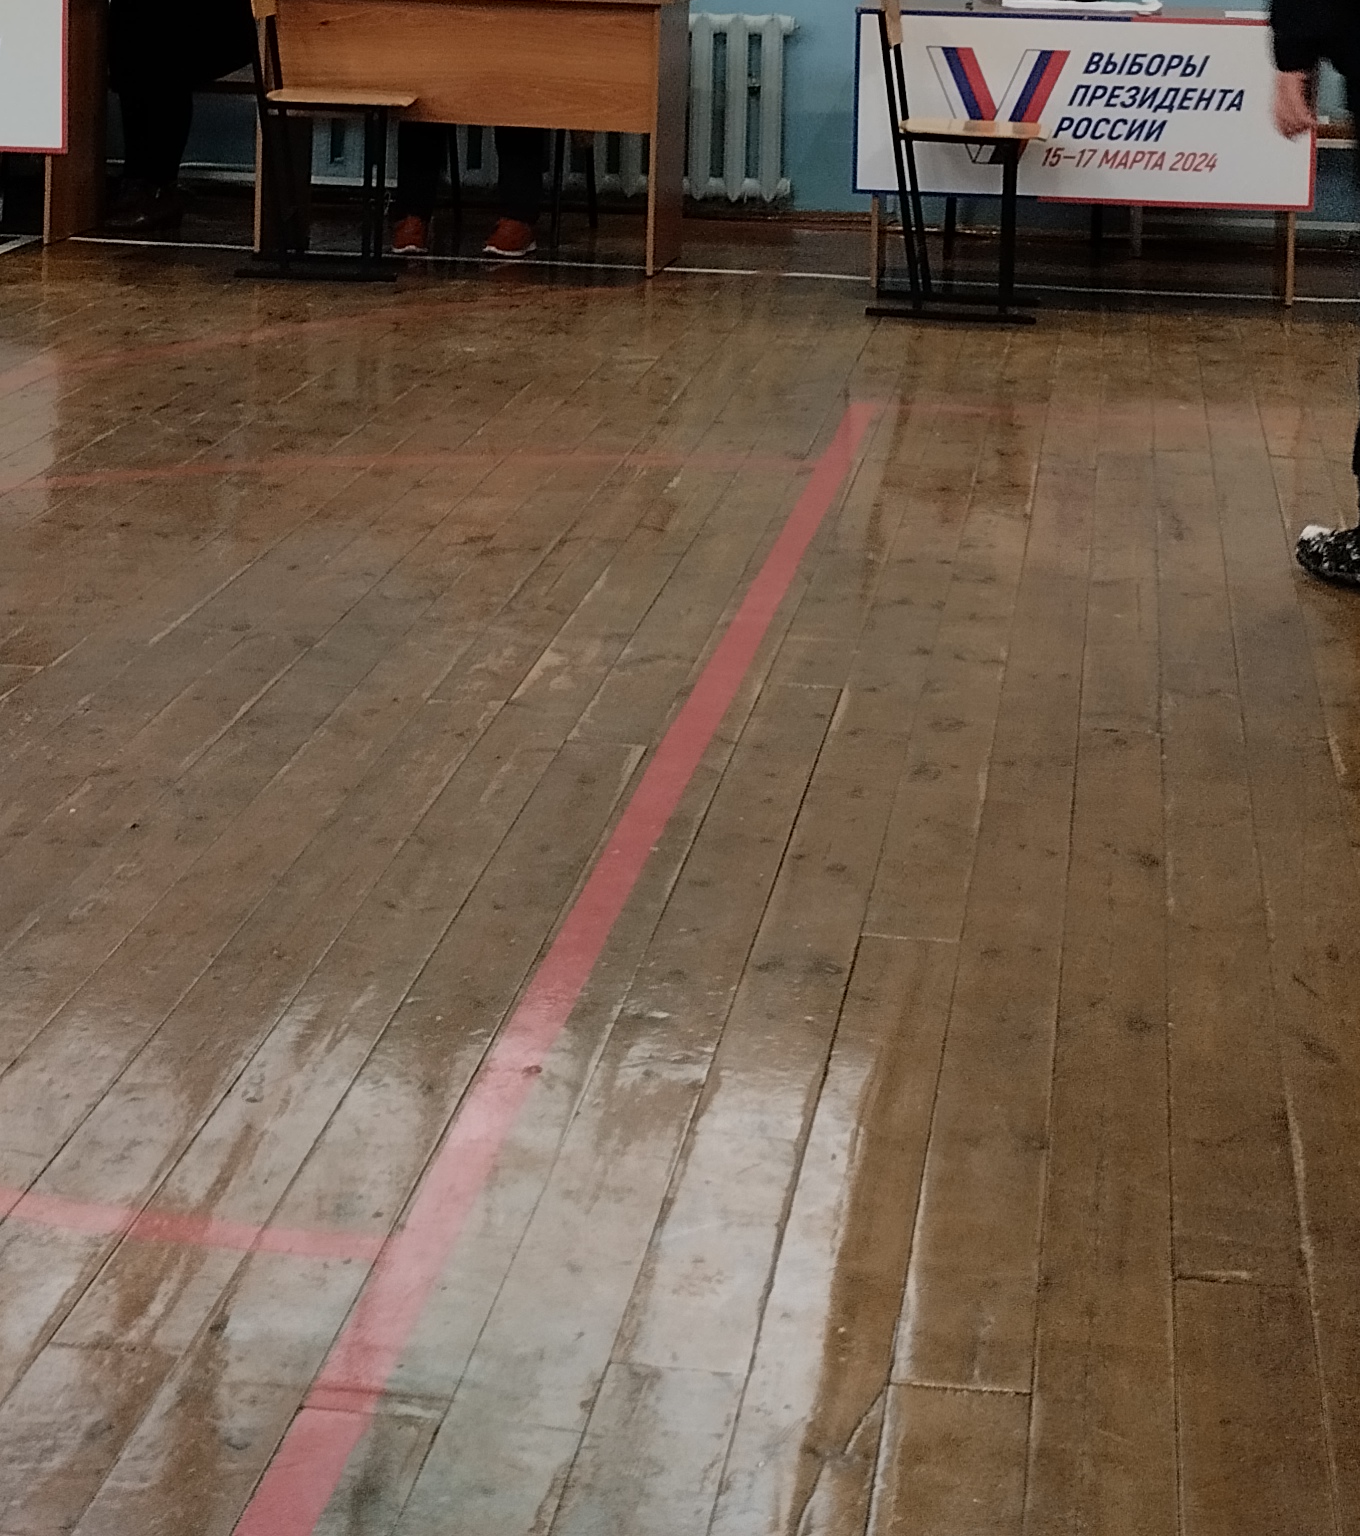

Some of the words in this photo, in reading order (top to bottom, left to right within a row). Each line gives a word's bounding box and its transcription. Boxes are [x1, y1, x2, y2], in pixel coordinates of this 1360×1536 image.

[1082, 51, 1211, 78] ВЫБОРЫ
[1068, 84, 1245, 113] ПРЕЗИДЕНТА
[1053, 116, 1168, 142] РОССИИ
[1099, 148, 1166, 171] МАРТА
[1168, 151, 1219, 173] 2024
